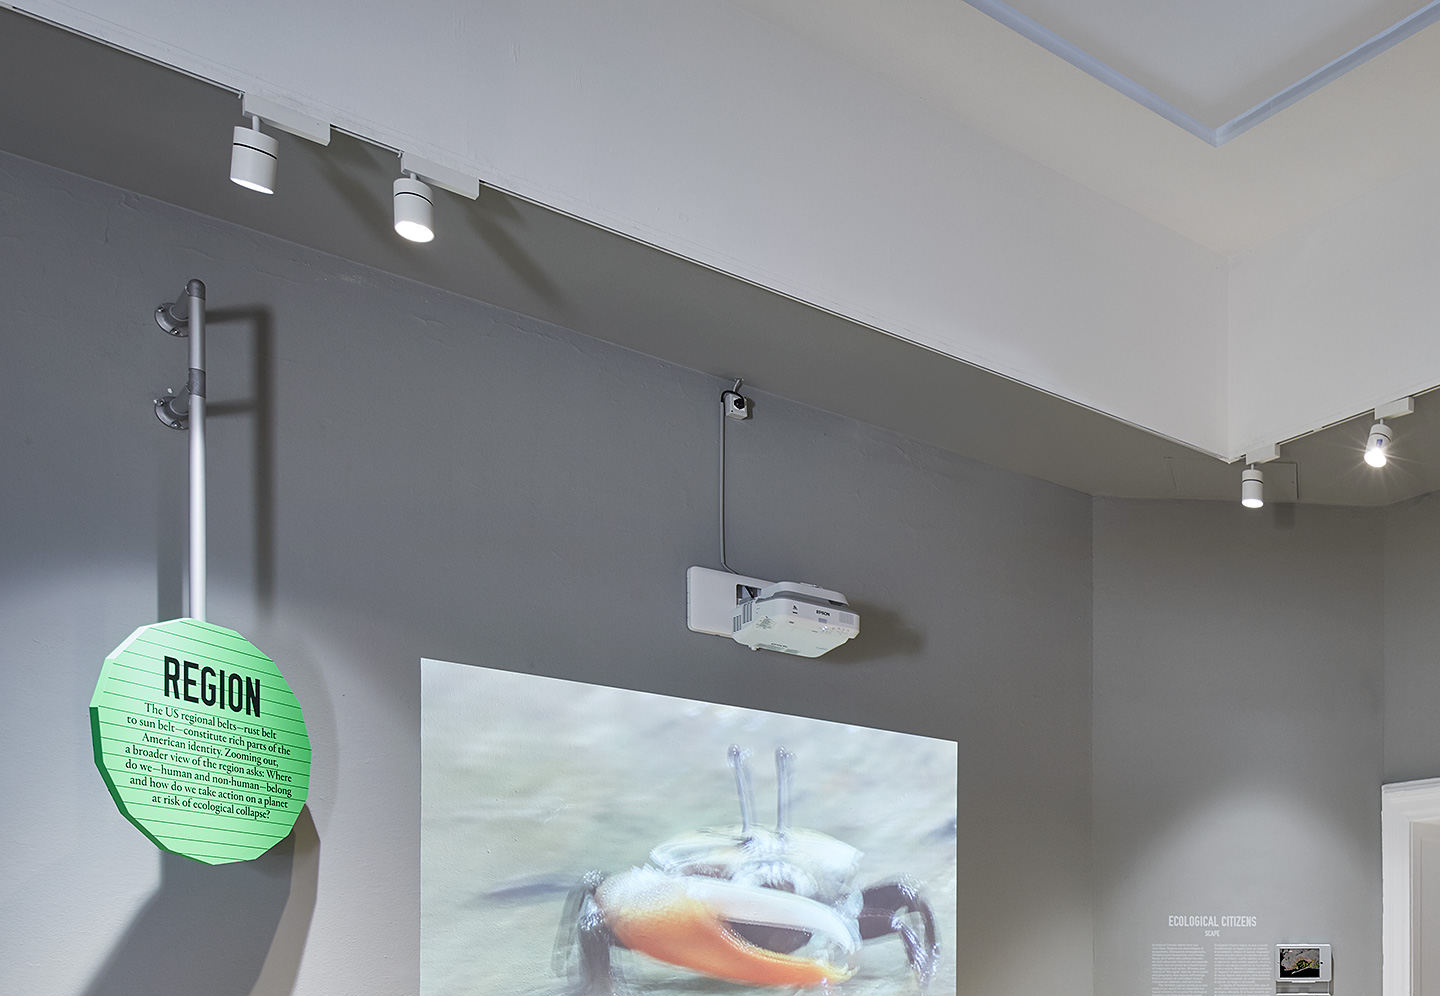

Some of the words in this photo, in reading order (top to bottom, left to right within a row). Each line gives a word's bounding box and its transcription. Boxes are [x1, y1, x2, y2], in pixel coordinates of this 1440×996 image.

[164, 655, 260, 718] REGION
[127, 716, 137, 724] to
[140, 719, 155, 728] sun
[229, 736, 244, 746] rich
[247, 741, 266, 750] parts
[268, 743, 278, 752] of
[278, 745, 290, 755] the
[144, 702, 163, 715] The
[165, 707, 179, 718] US
[181, 713, 215, 726] regional
[262, 728, 277, 739] belt
[133, 745, 168, 760] broader
[170, 753, 190, 763] view
[192, 756, 202, 766] of
[203, 758, 217, 769] the
[219, 764, 244, 774] region
[246, 767, 264, 777] asks:
[267, 770, 292, 782] Where
[142, 733, 185, 749] American
[188, 741, 222, 758] identity.
[225, 748, 262, 766] Zooming
[263, 757, 278, 767] out,
[125, 759, 137, 769] do
[194, 772, 210, 781] and
[130, 776, 147, 786] and
[150, 777, 169, 788] how
[171, 781, 182, 791] do
[184, 786, 196, 794] we
[198, 787, 216, 796] take
[218, 791, 244, 801] action
[246, 796, 256, 804] on
[264, 796, 288, 808] planet
[163, 796, 180, 806] risk
[182, 798, 193, 807] of
[193, 800, 234, 814] ecological
[236, 806, 271, 820] collapse?
[1168, 915, 1219, 927] ECOLOGICAL
[1221, 915, 1257, 927] CITIZENS
